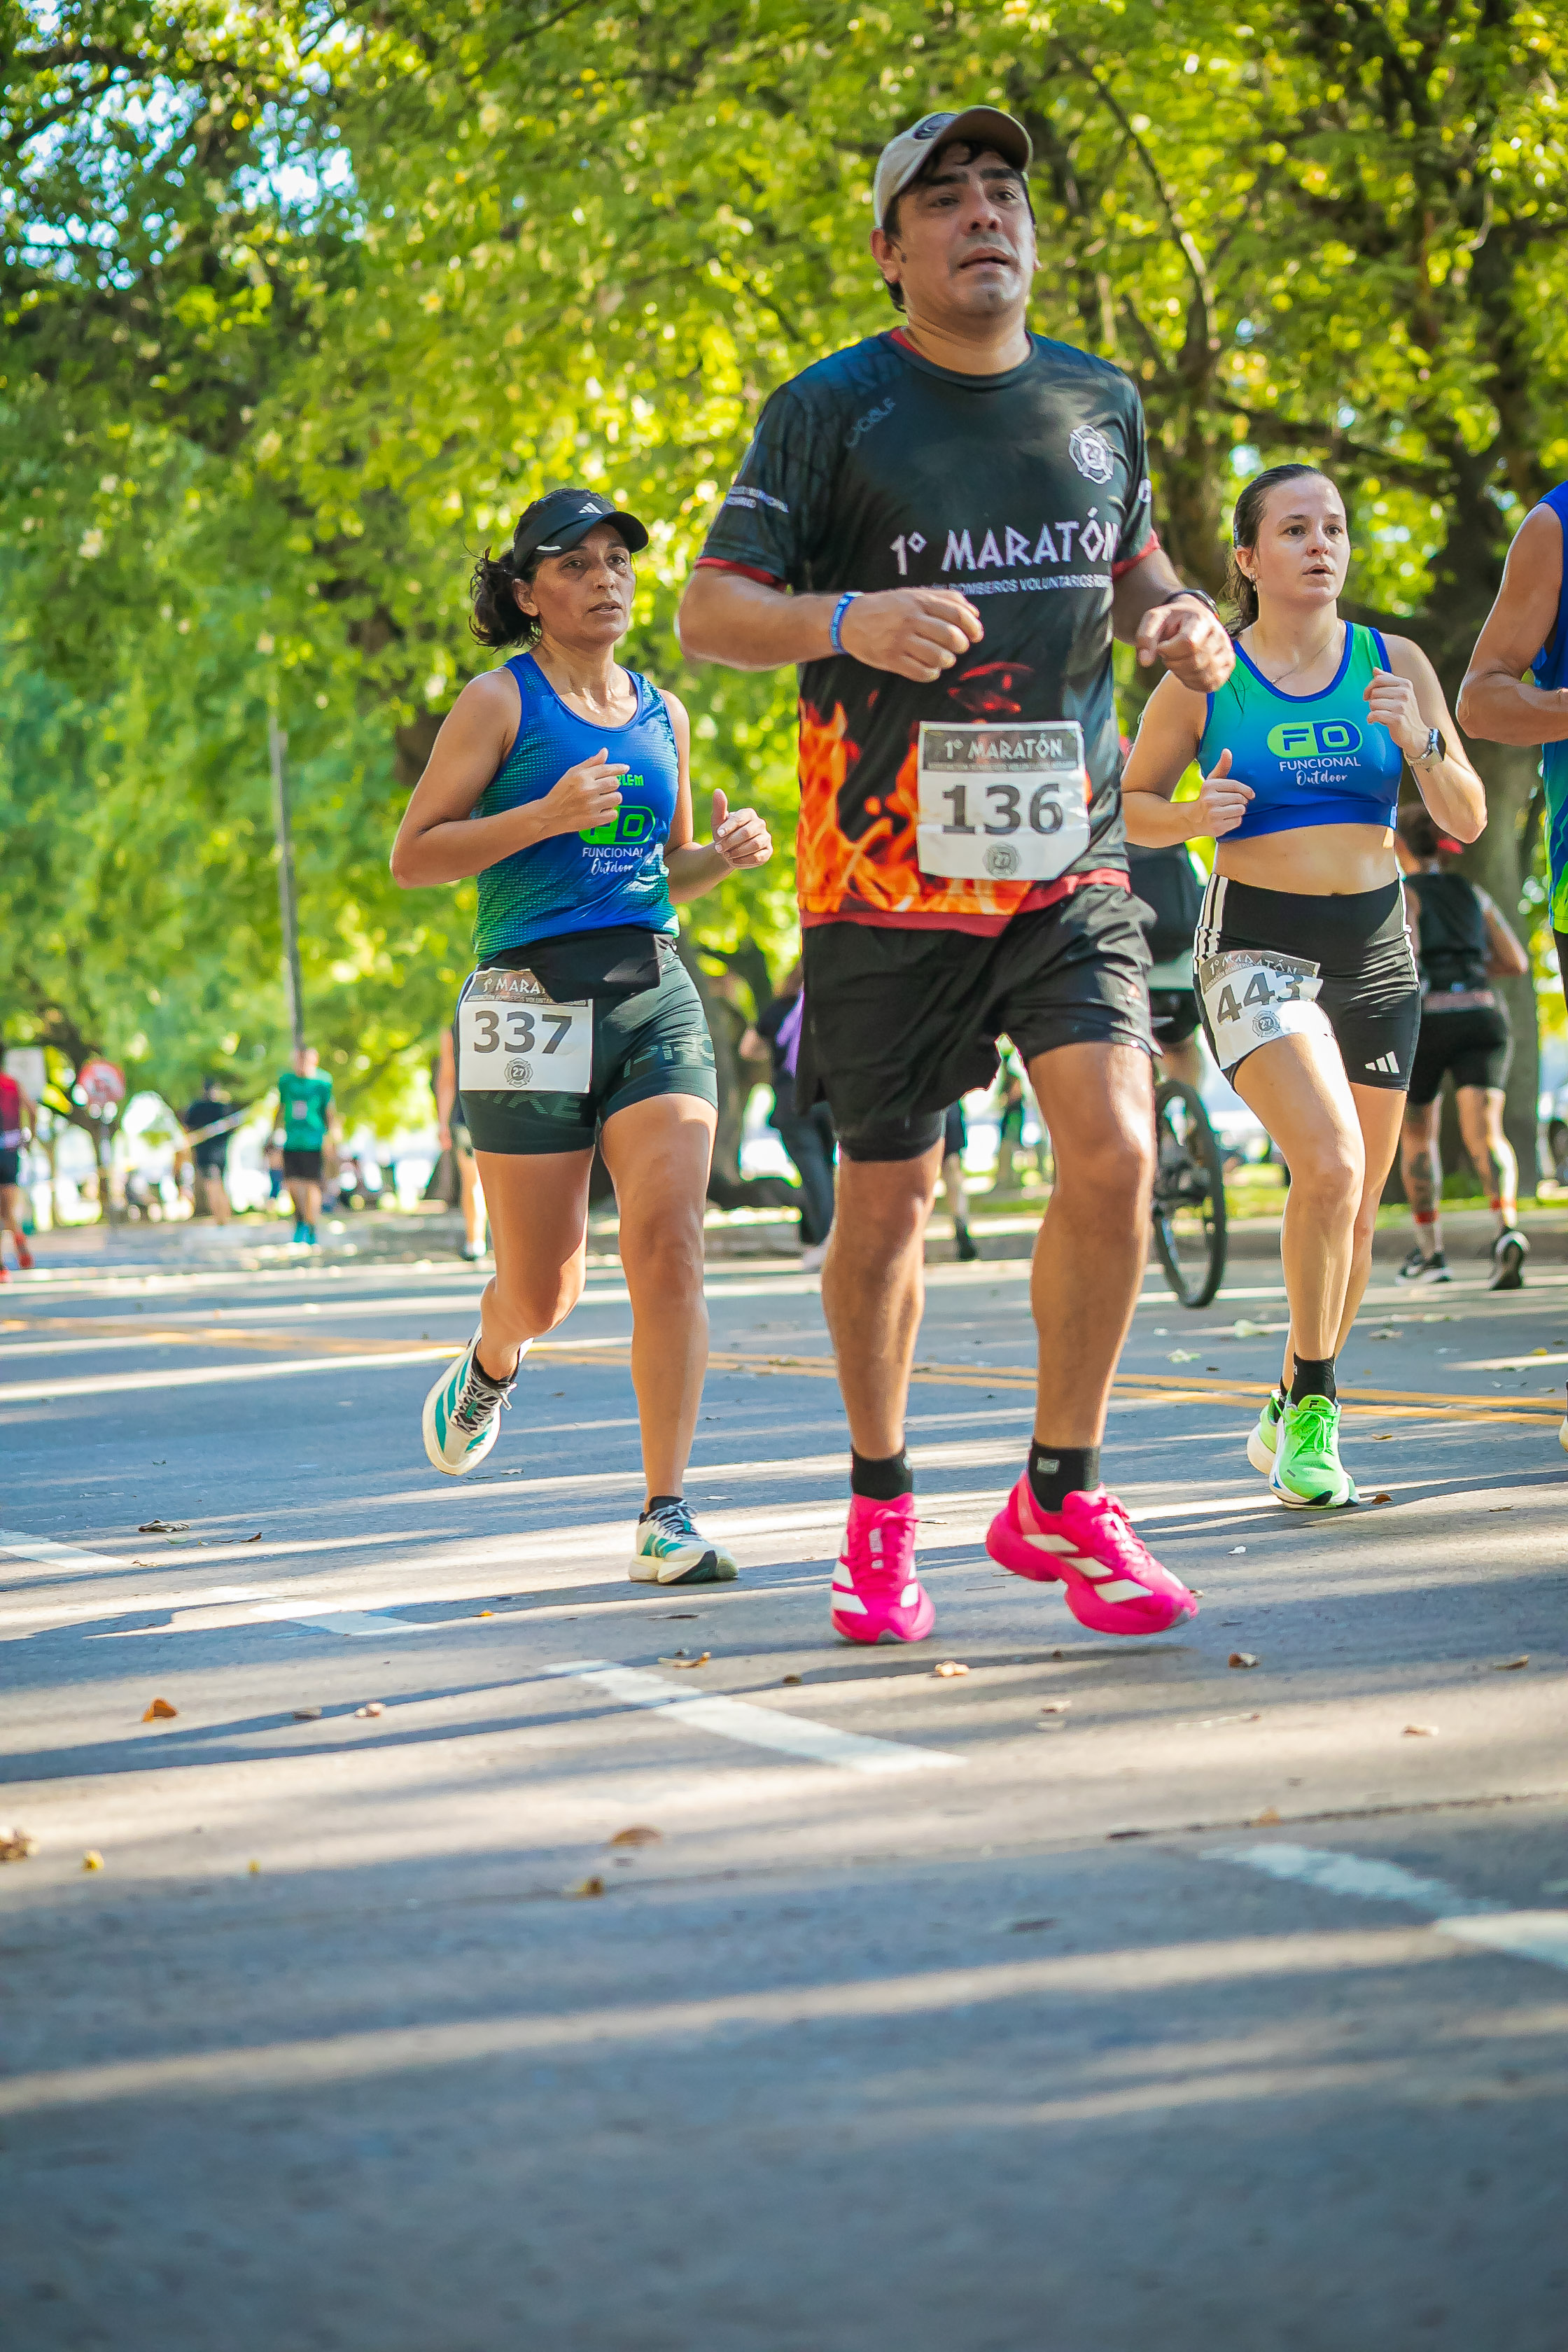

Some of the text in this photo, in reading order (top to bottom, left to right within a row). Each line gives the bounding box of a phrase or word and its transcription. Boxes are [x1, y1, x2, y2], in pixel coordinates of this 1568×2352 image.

[941, 506, 1119, 573] MARATÓN
[967, 733, 1063, 760] MARATÓN
[1279, 756, 1362, 772] FUNCIONAL
[1296, 769, 1348, 786] Outdoor
[941, 783, 1064, 836] 136
[590, 858, 634, 875] Outdoor
[473, 1010, 573, 1054] 337
[512, 1067, 525, 1077] 27
